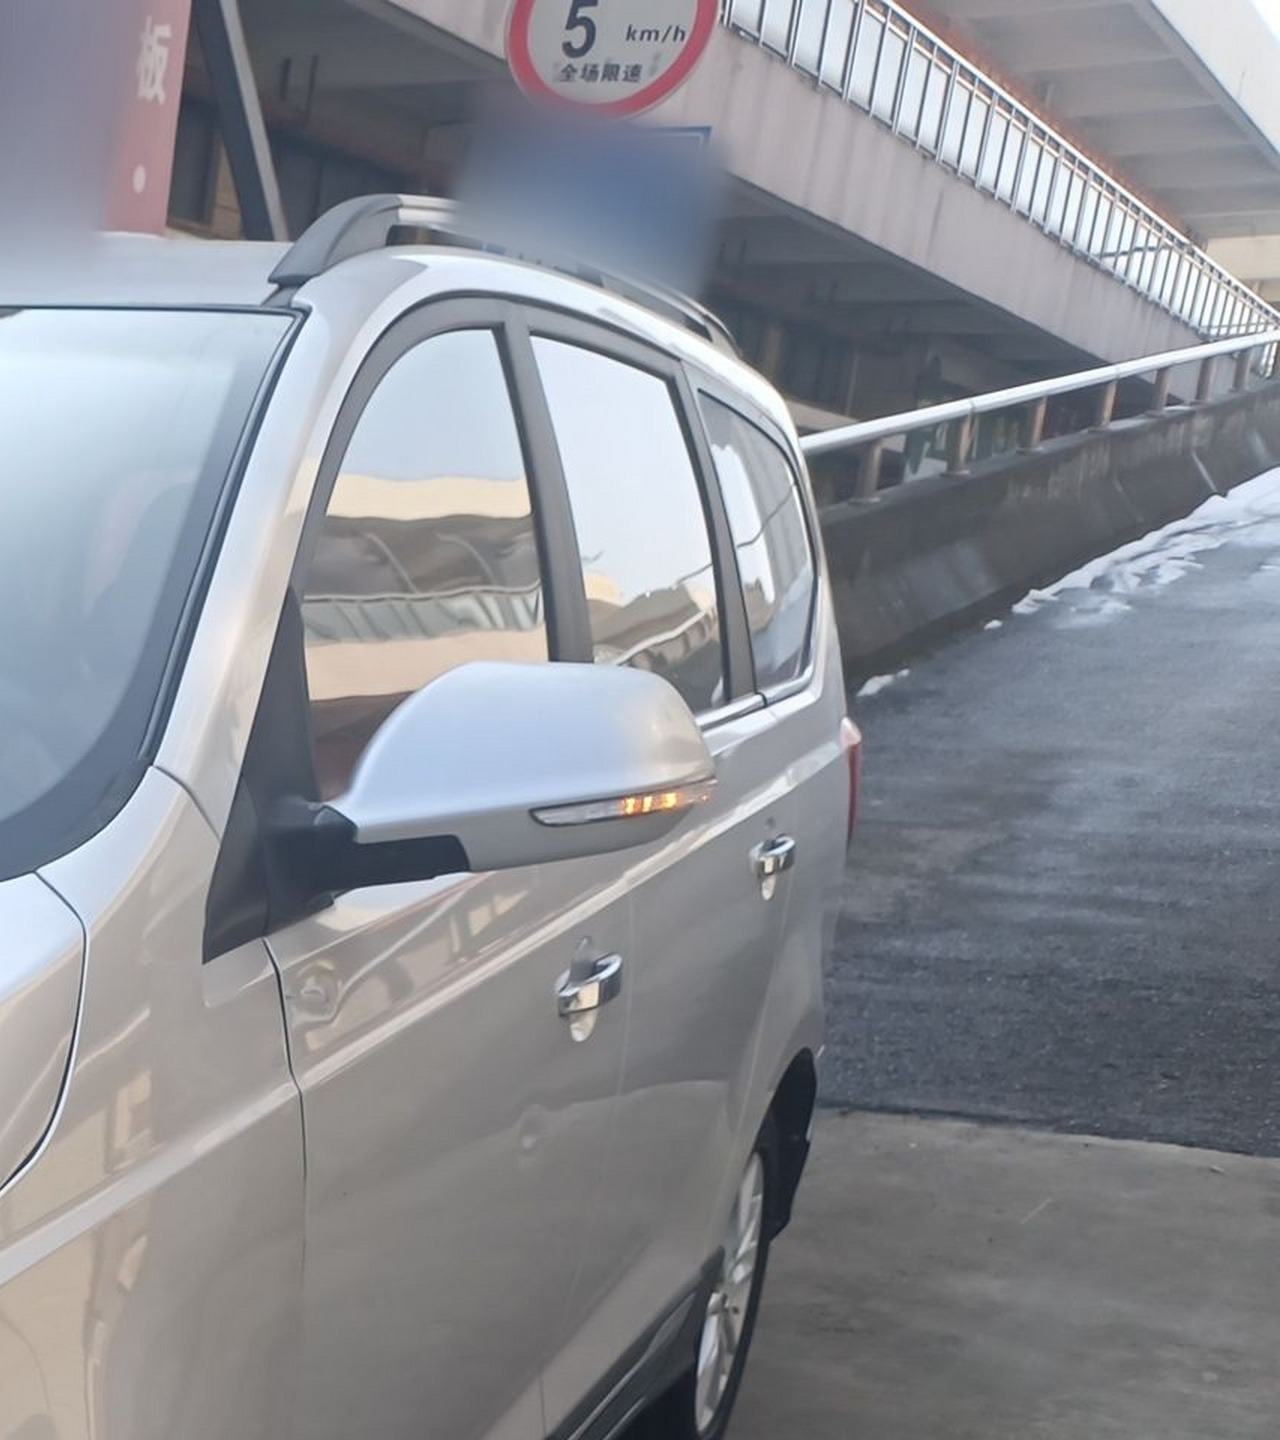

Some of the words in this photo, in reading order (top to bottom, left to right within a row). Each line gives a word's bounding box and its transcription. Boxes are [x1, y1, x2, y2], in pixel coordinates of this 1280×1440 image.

[562, 0, 599, 58] 5
[625, 24, 686, 43] km/h
[559, 63, 642, 83] 全场限速
